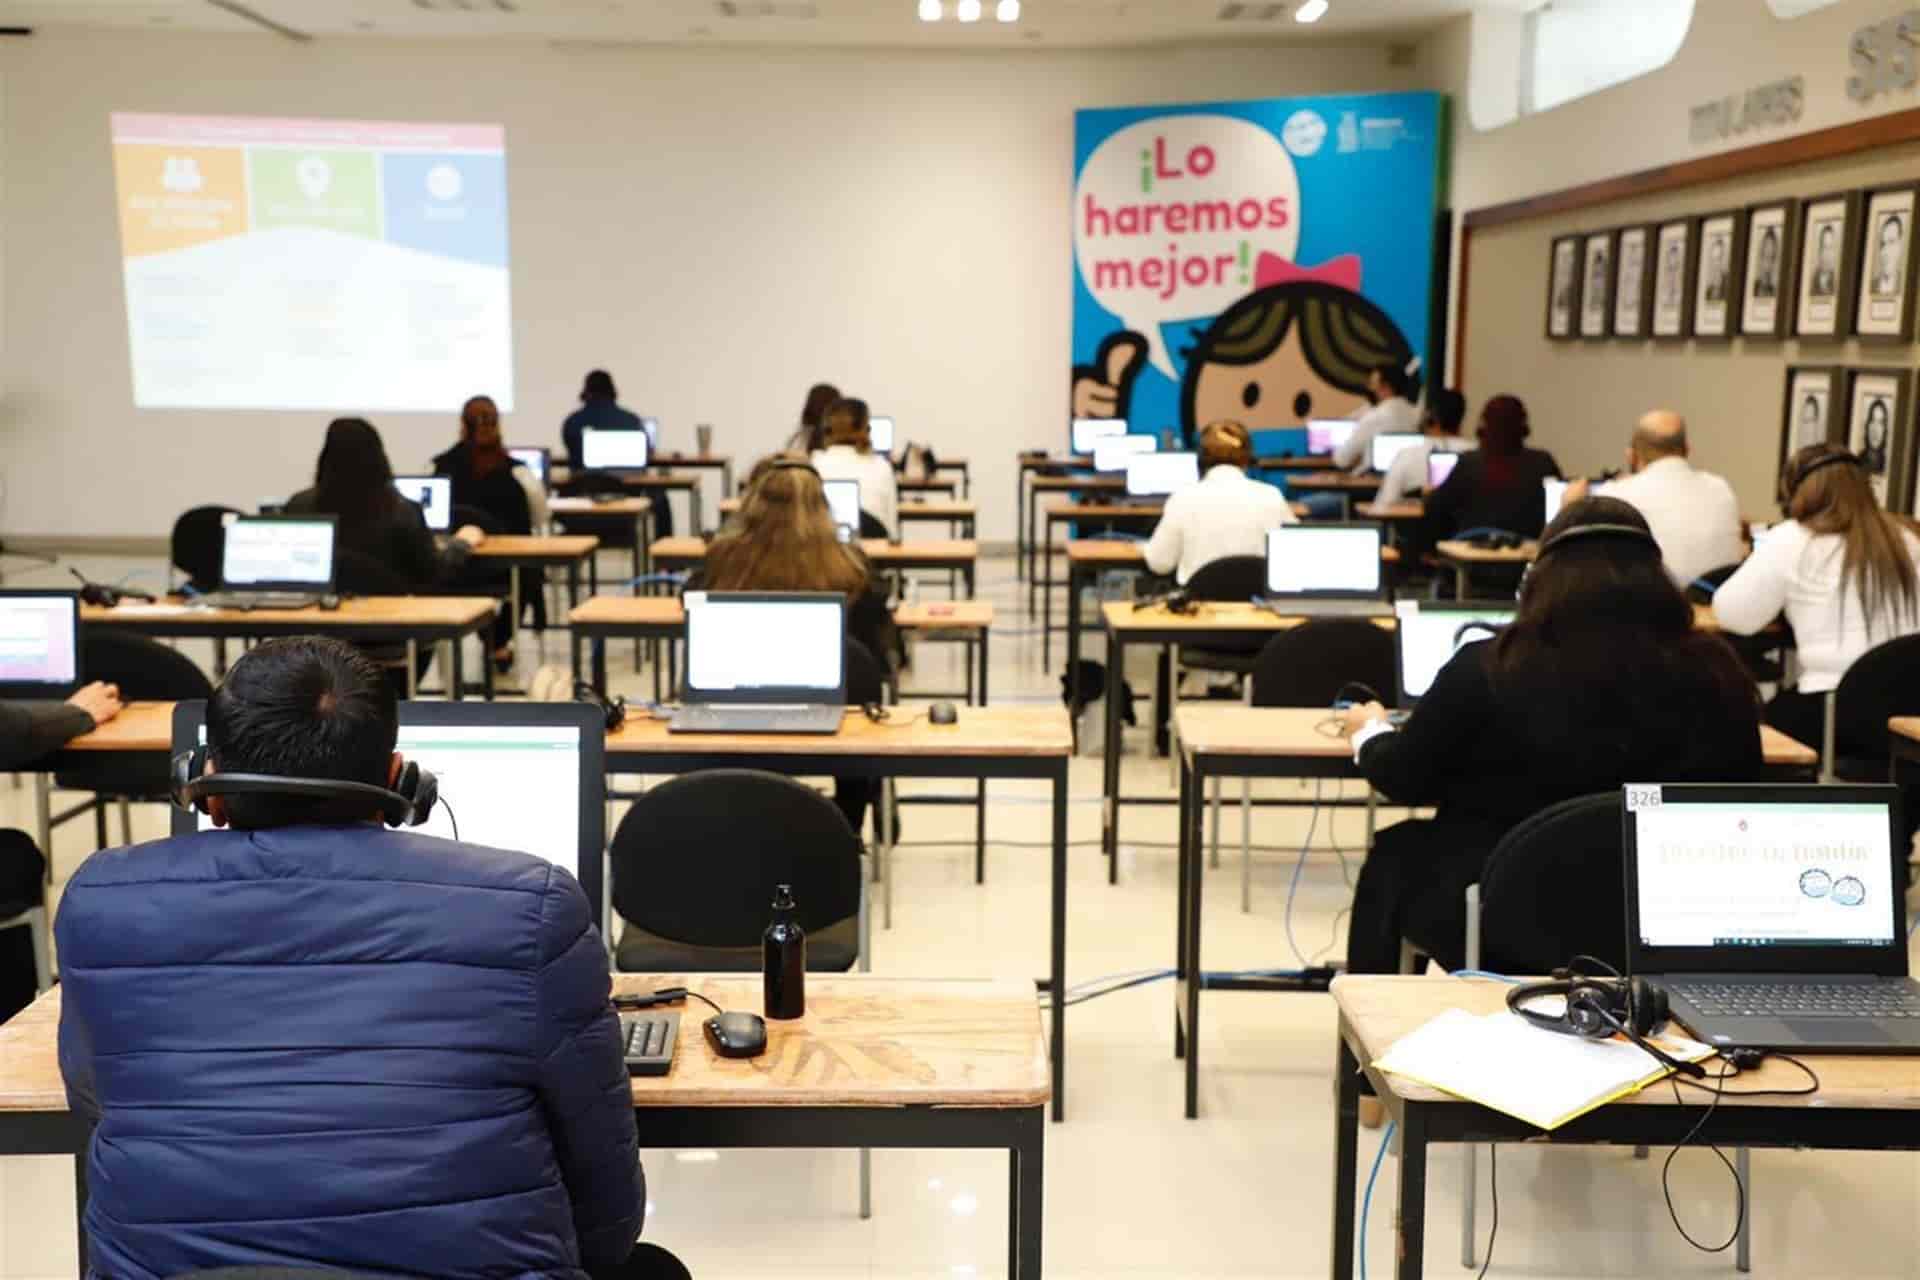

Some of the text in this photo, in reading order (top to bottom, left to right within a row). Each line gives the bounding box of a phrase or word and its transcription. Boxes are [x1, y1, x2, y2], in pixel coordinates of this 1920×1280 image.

[1141, 136, 1216, 193] ¡Lo
[1084, 194, 1289, 237] haremos
[1093, 240, 1250, 300] mejor!
[1630, 791, 1660, 808] 326
